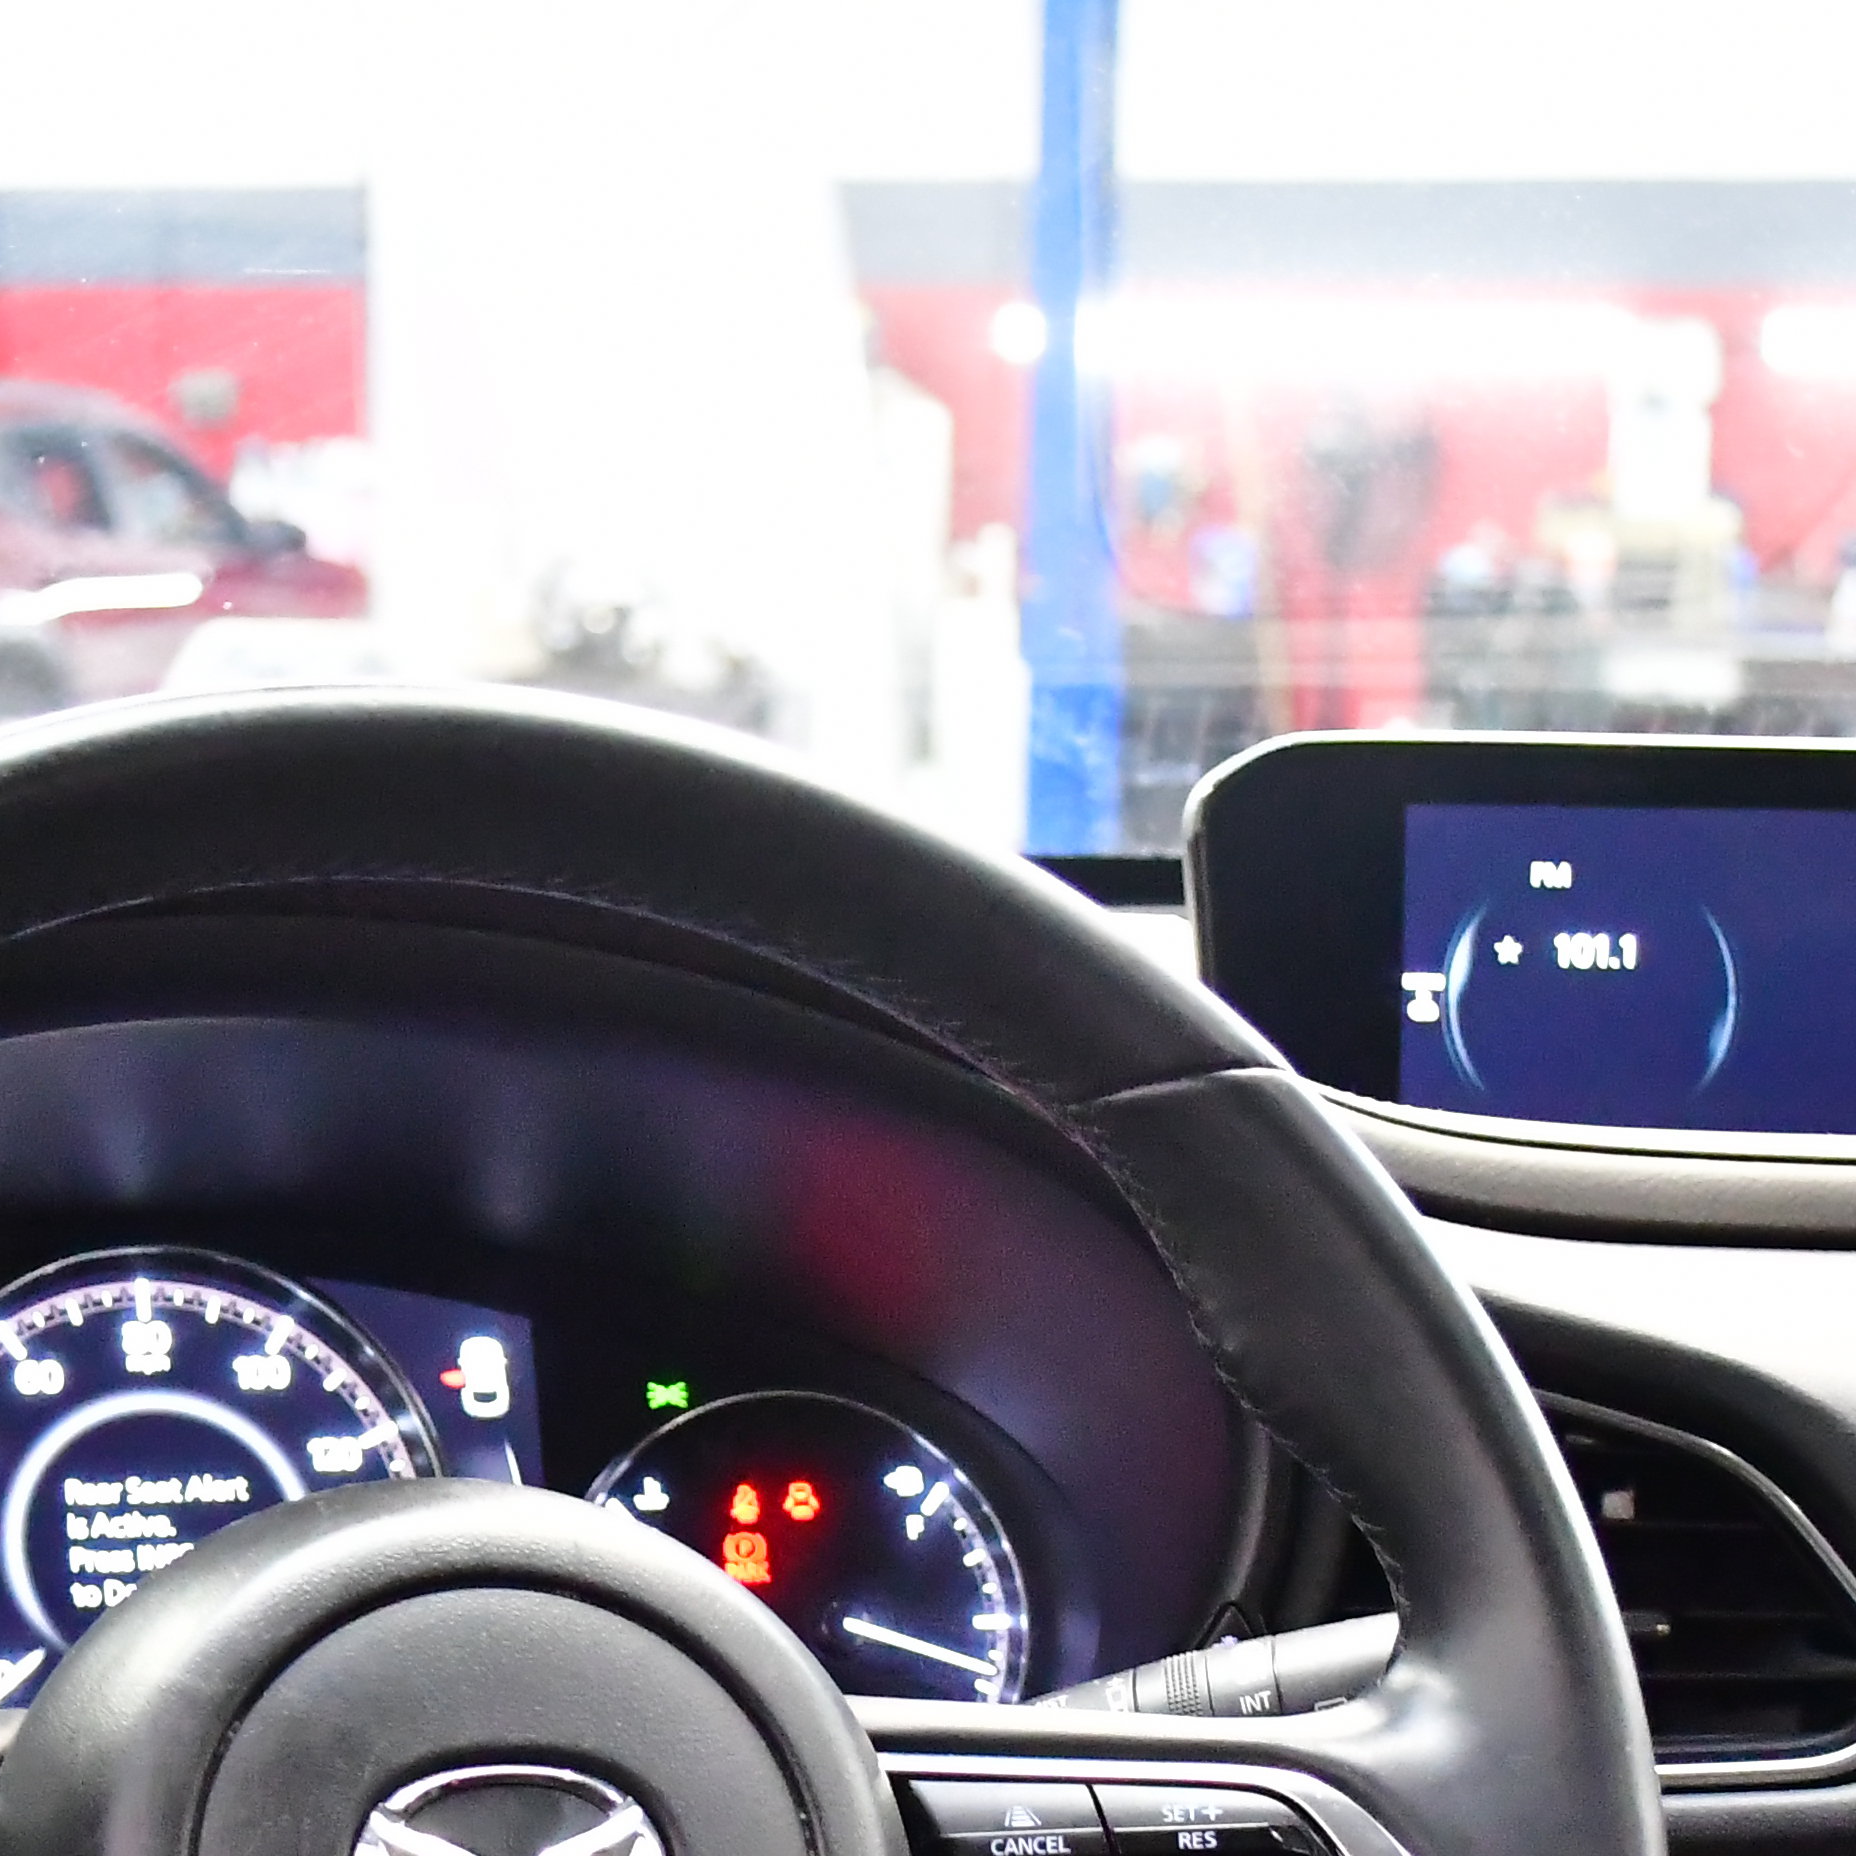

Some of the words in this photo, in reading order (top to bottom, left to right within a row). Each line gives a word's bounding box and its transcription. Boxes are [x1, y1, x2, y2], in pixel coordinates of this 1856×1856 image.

[1553, 932, 1638, 969] 101.1
[121, 1319, 172, 1355] 80
[14, 1359, 65, 1395] 60
[232, 1354, 291, 1390] 100
[307, 1436, 363, 1473] 120
[64, 1478, 123, 1505] Rear
[125, 1476, 183, 1505] Seat
[184, 1473, 250, 1502] Alert
[90, 1510, 177, 1539] Active.
[70, 1582, 102, 1608] to
[1239, 1691, 1272, 1715] INT
[990, 1834, 1072, 1856] CANCEL
[1177, 1831, 1218, 1850] RES
